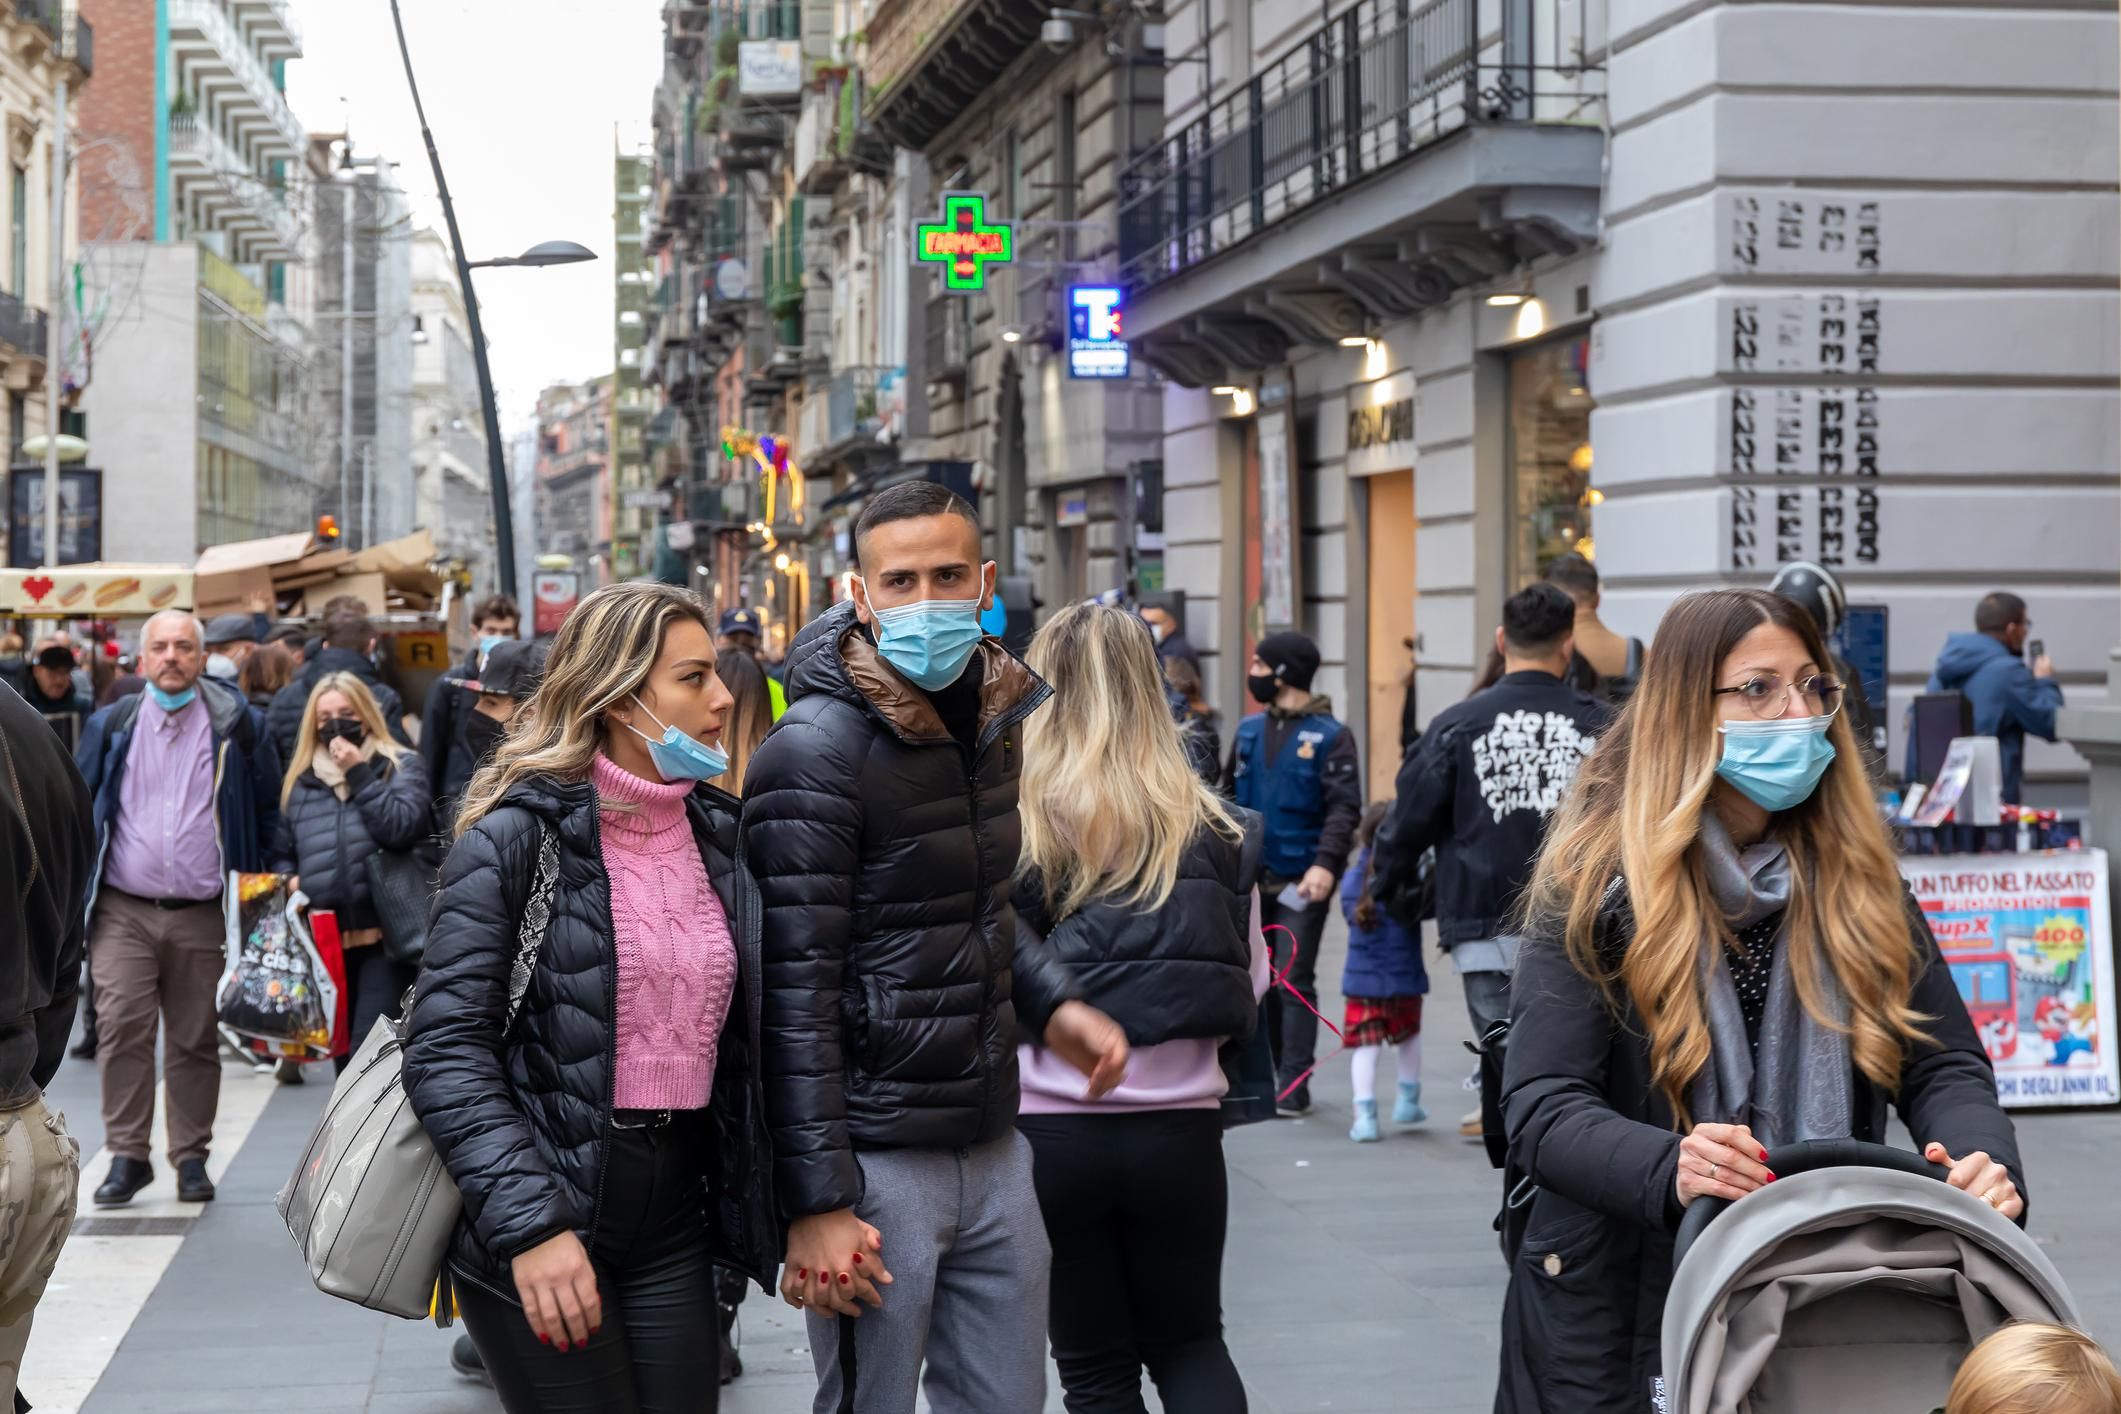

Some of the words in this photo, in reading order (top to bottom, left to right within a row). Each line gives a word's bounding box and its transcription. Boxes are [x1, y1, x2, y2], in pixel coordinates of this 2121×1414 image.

[926, 232, 1004, 254] FARMACIA
[1913, 876, 1937, 895] UN
[1940, 874, 1989, 894] TUFFO
[1993, 873, 2021, 892] NEL
[2025, 871, 2095, 891] PASSATO
[2033, 927, 2085, 943] 400
[2021, 1077, 2058, 1096] DEGLI
[2062, 1075, 2091, 1093] ANNI
